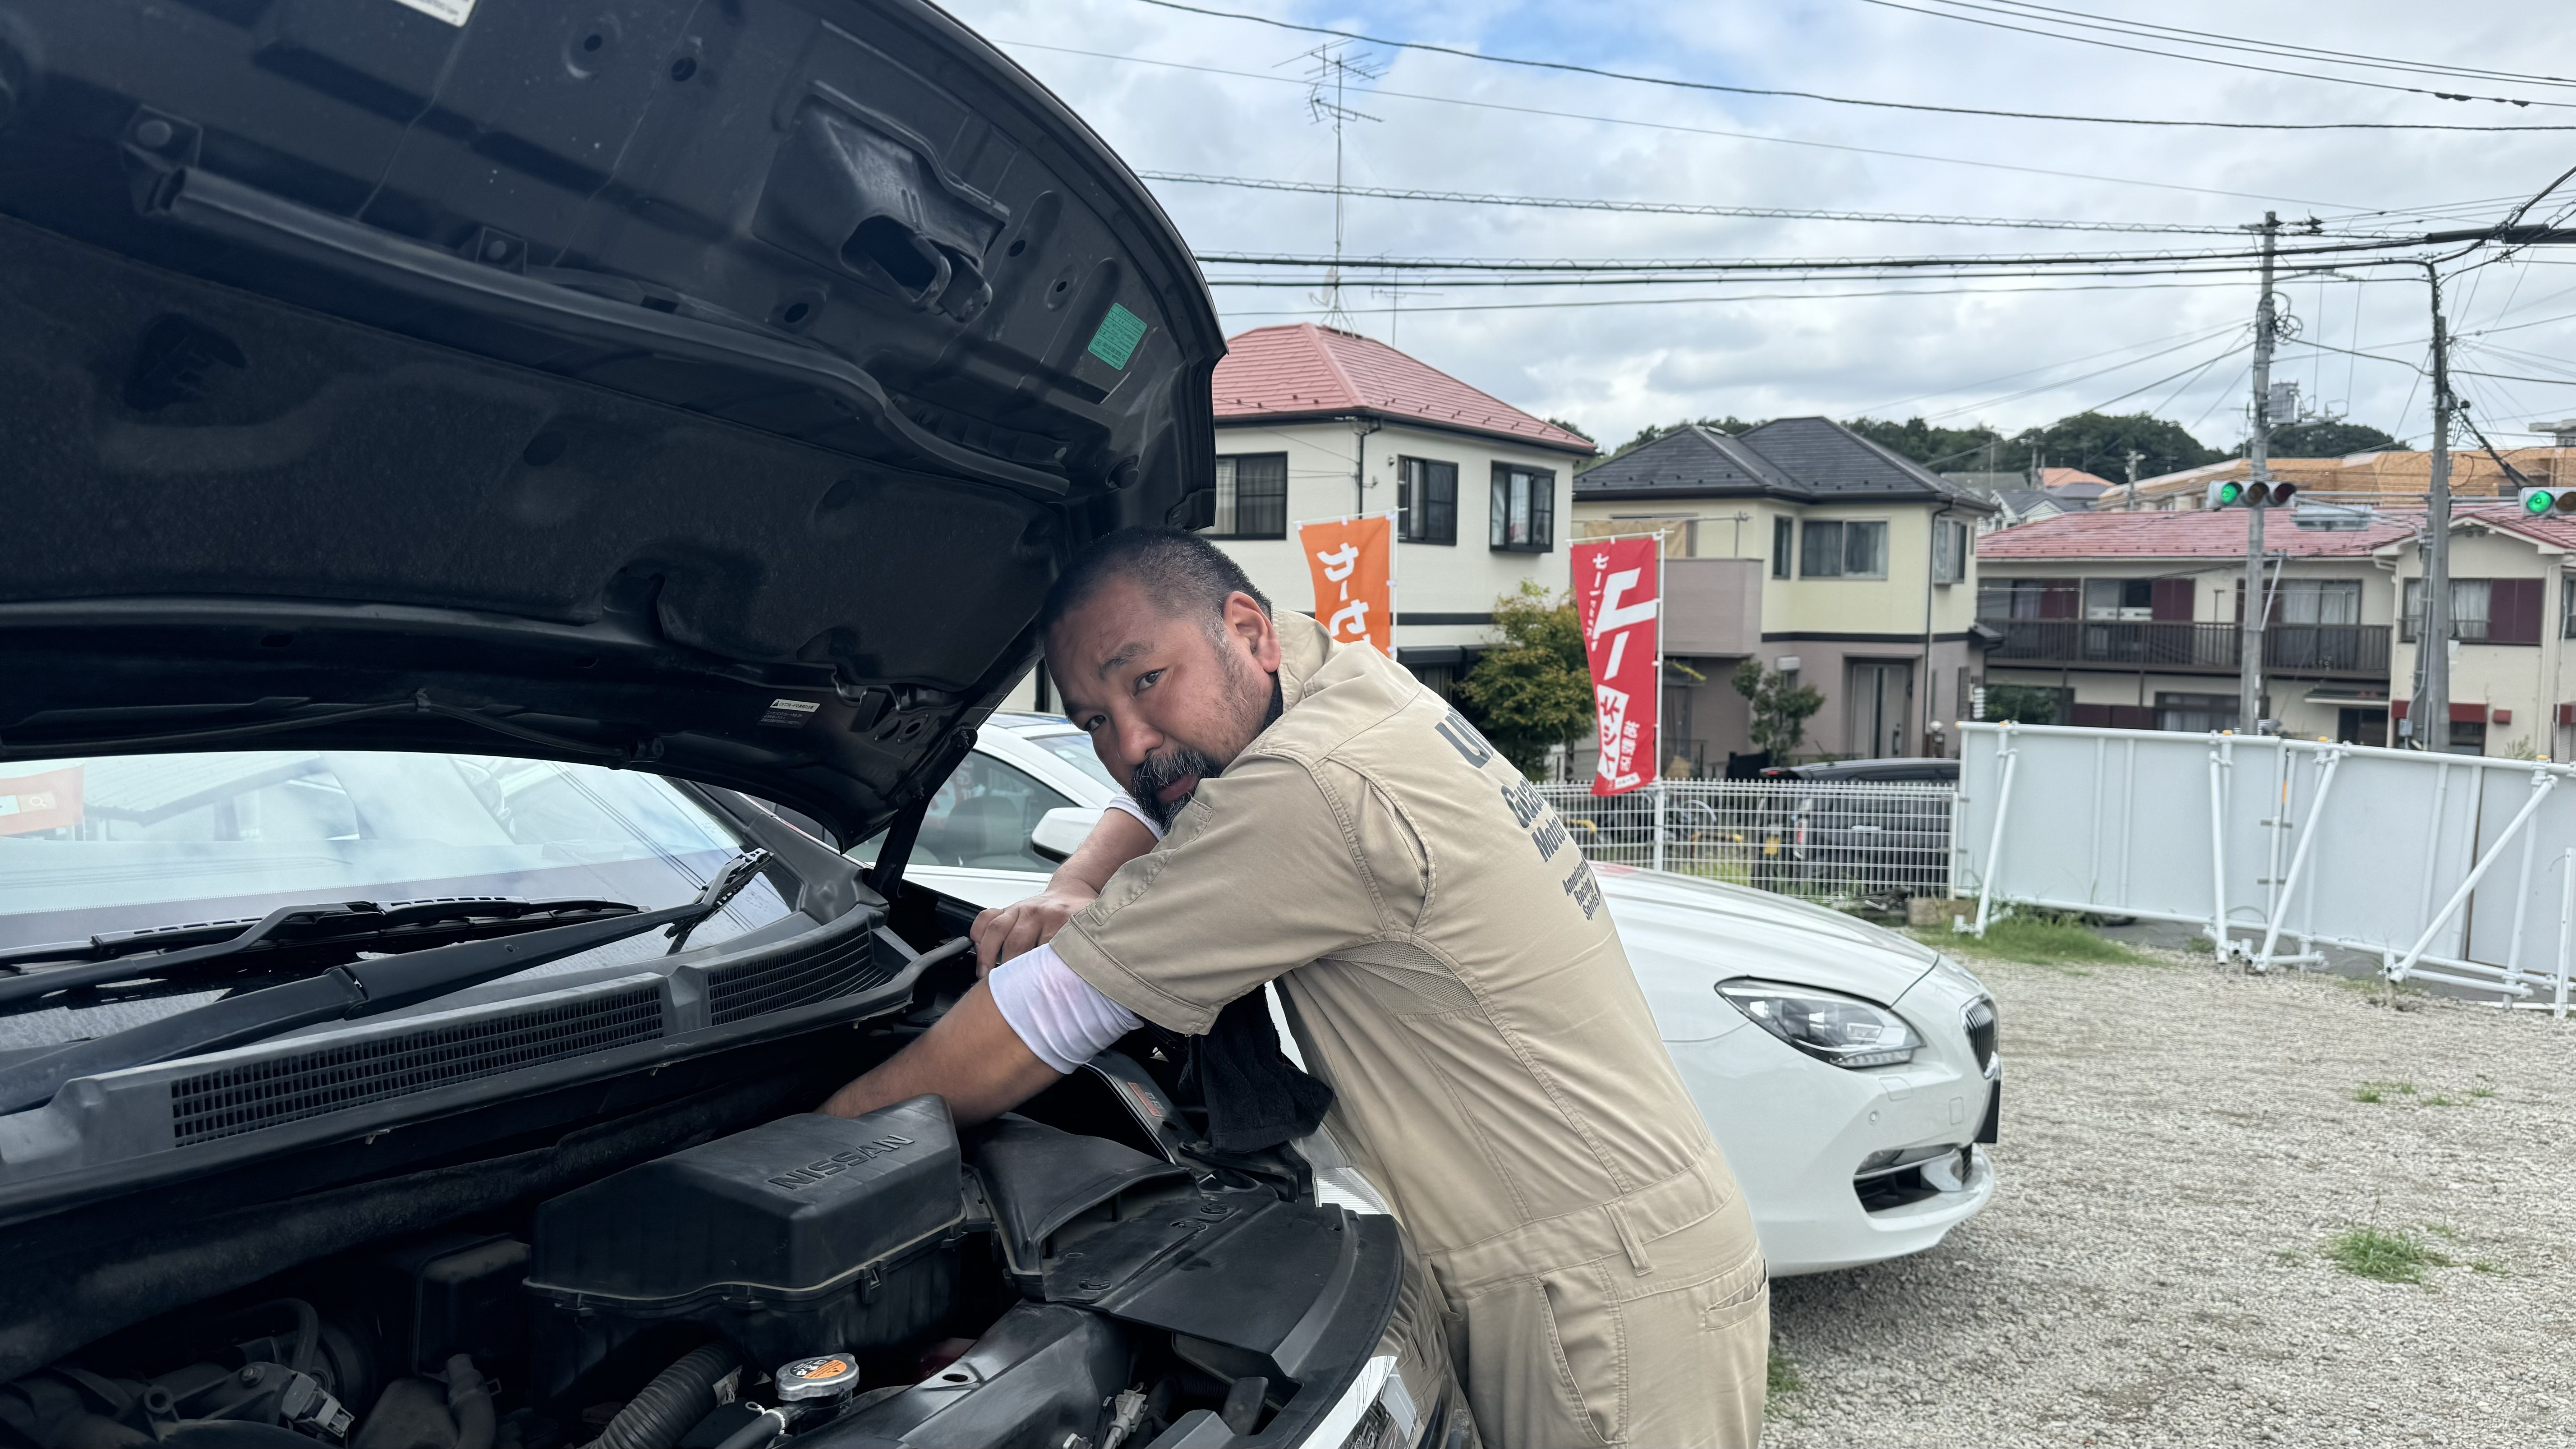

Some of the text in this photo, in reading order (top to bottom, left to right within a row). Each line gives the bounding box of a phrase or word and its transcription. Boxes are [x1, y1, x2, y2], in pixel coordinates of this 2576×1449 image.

[1316, 542, 1371, 643] カーセ
[1501, 777, 1544, 828] Guar
[1573, 878, 1594, 906] Racing
[1582, 893, 1600, 921] Spirits
[768, 1134, 915, 1190] NISSAN
